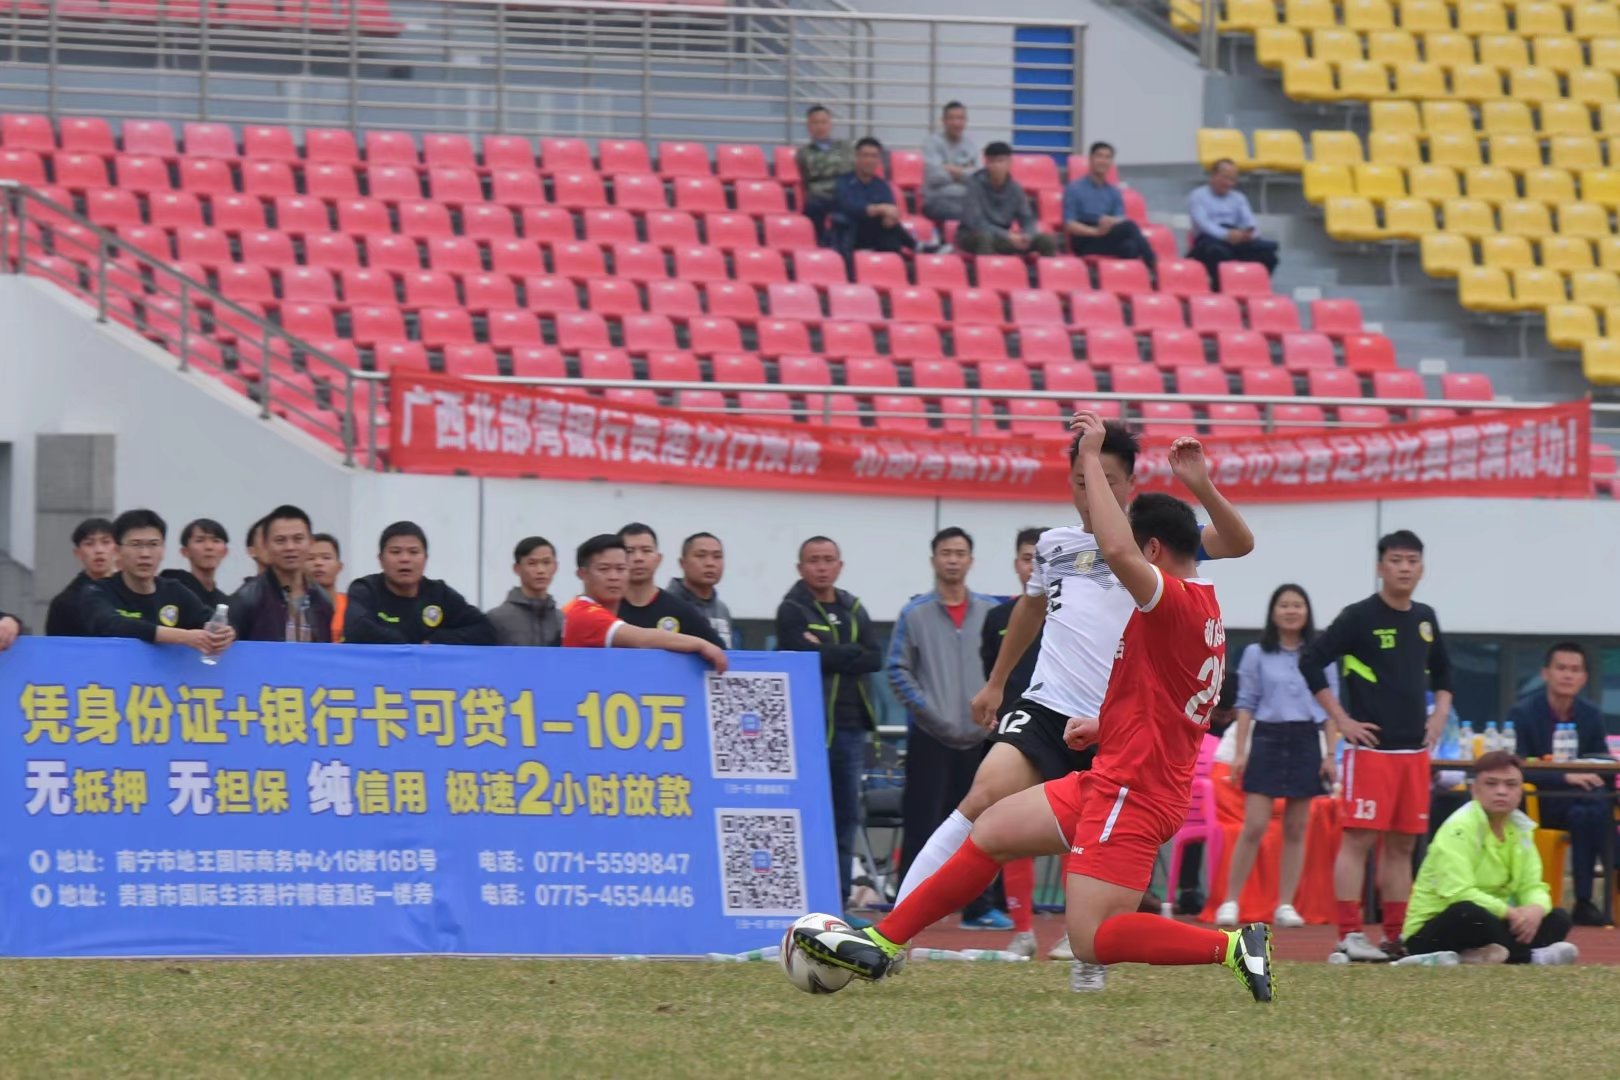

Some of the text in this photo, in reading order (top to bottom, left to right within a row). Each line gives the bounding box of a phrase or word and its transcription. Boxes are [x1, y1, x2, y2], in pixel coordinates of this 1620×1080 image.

[20, 683, 685, 750] 凭身份证+银行卡可贷1-10万
[997, 709, 1032, 735] 12
[26, 760, 692, 817] 无抵押 无担保 纯信用 极速2小时放款
[1354, 798, 1377, 820] 13
